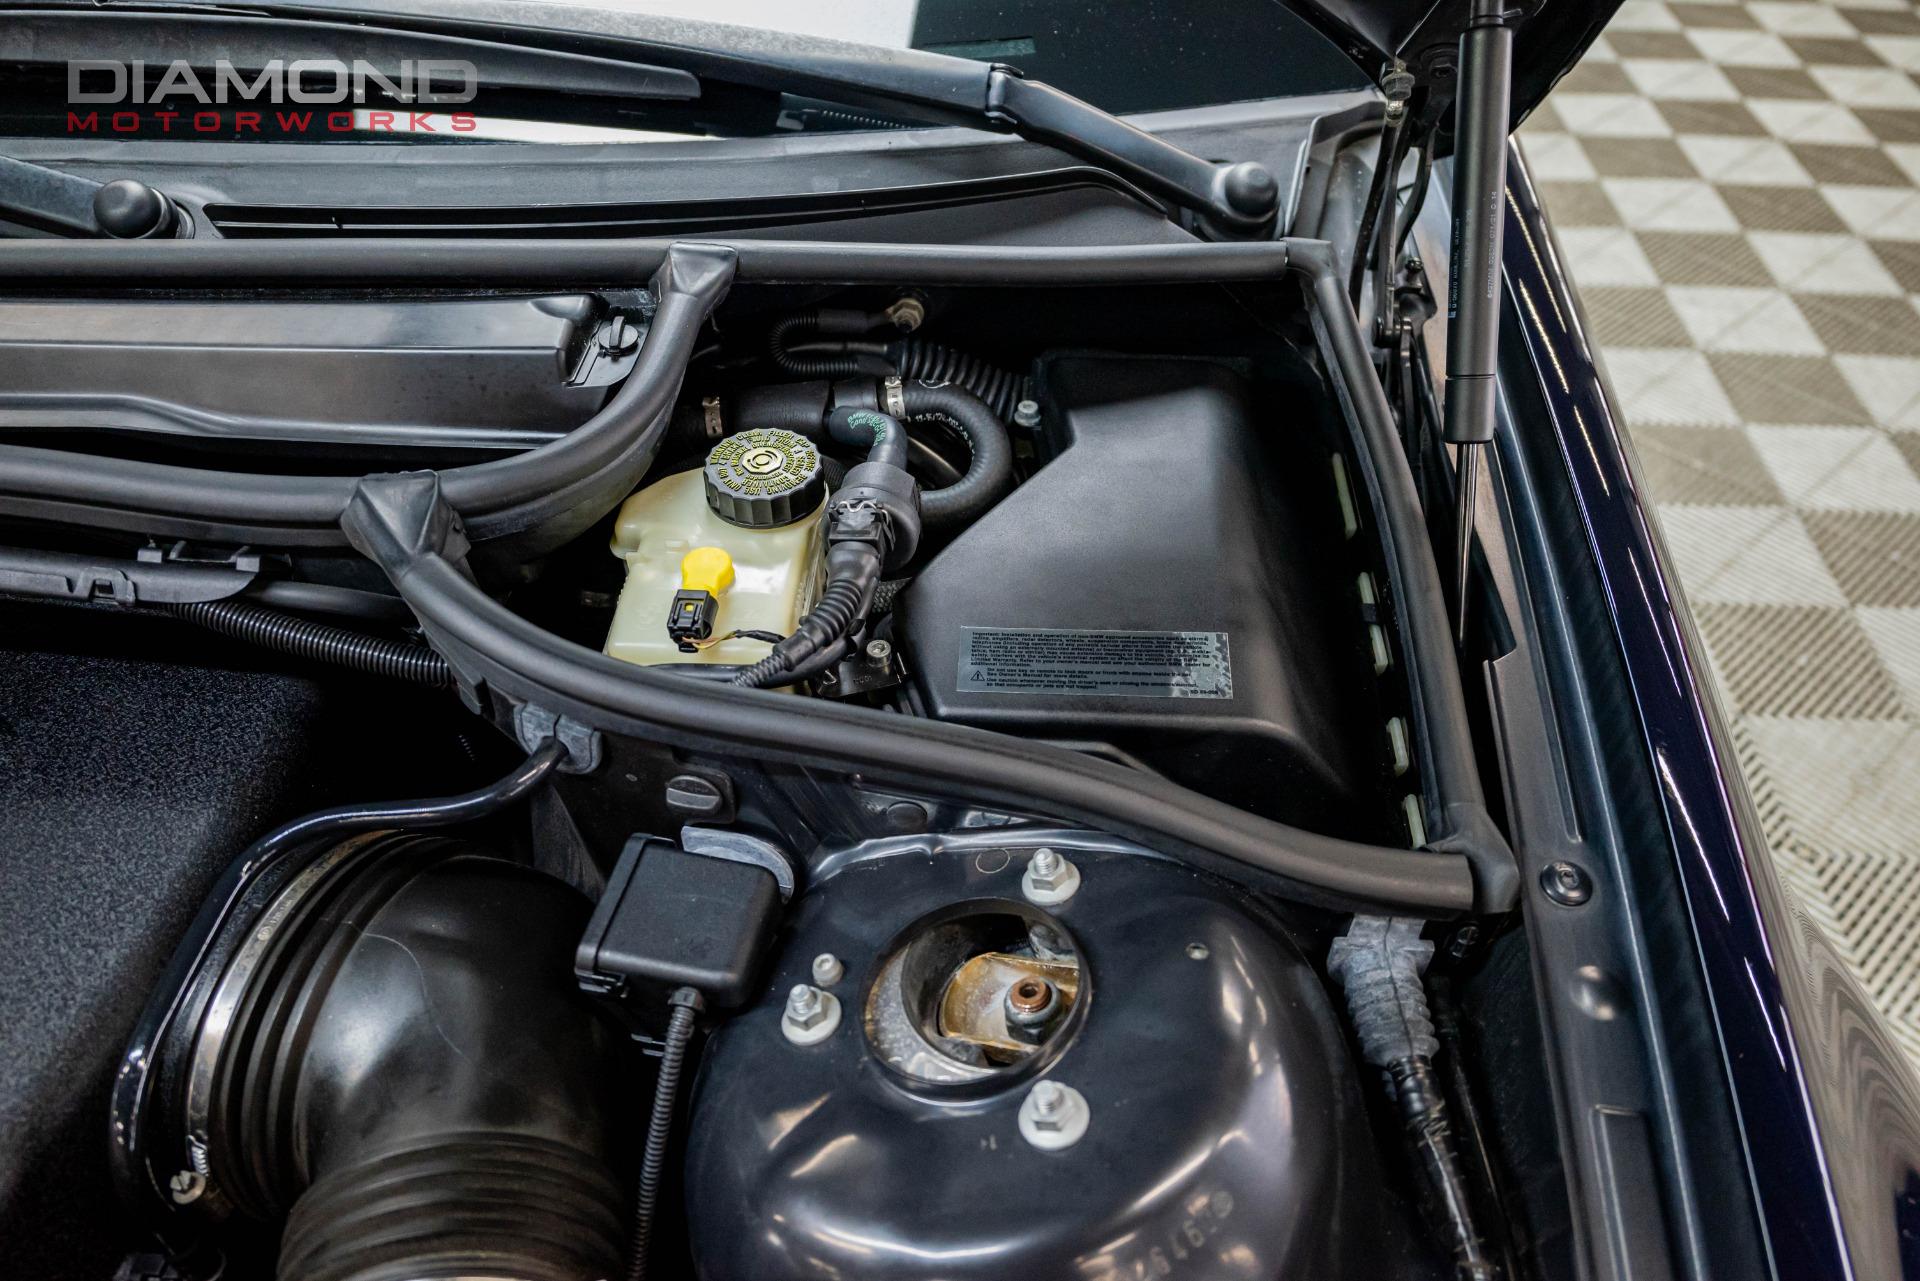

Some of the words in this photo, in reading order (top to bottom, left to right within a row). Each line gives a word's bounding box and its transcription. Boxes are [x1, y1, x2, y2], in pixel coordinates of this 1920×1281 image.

[796, 439, 810, 447] CAP
[723, 479, 742, 491] ONLY
[745, 487, 761, 495] USE
